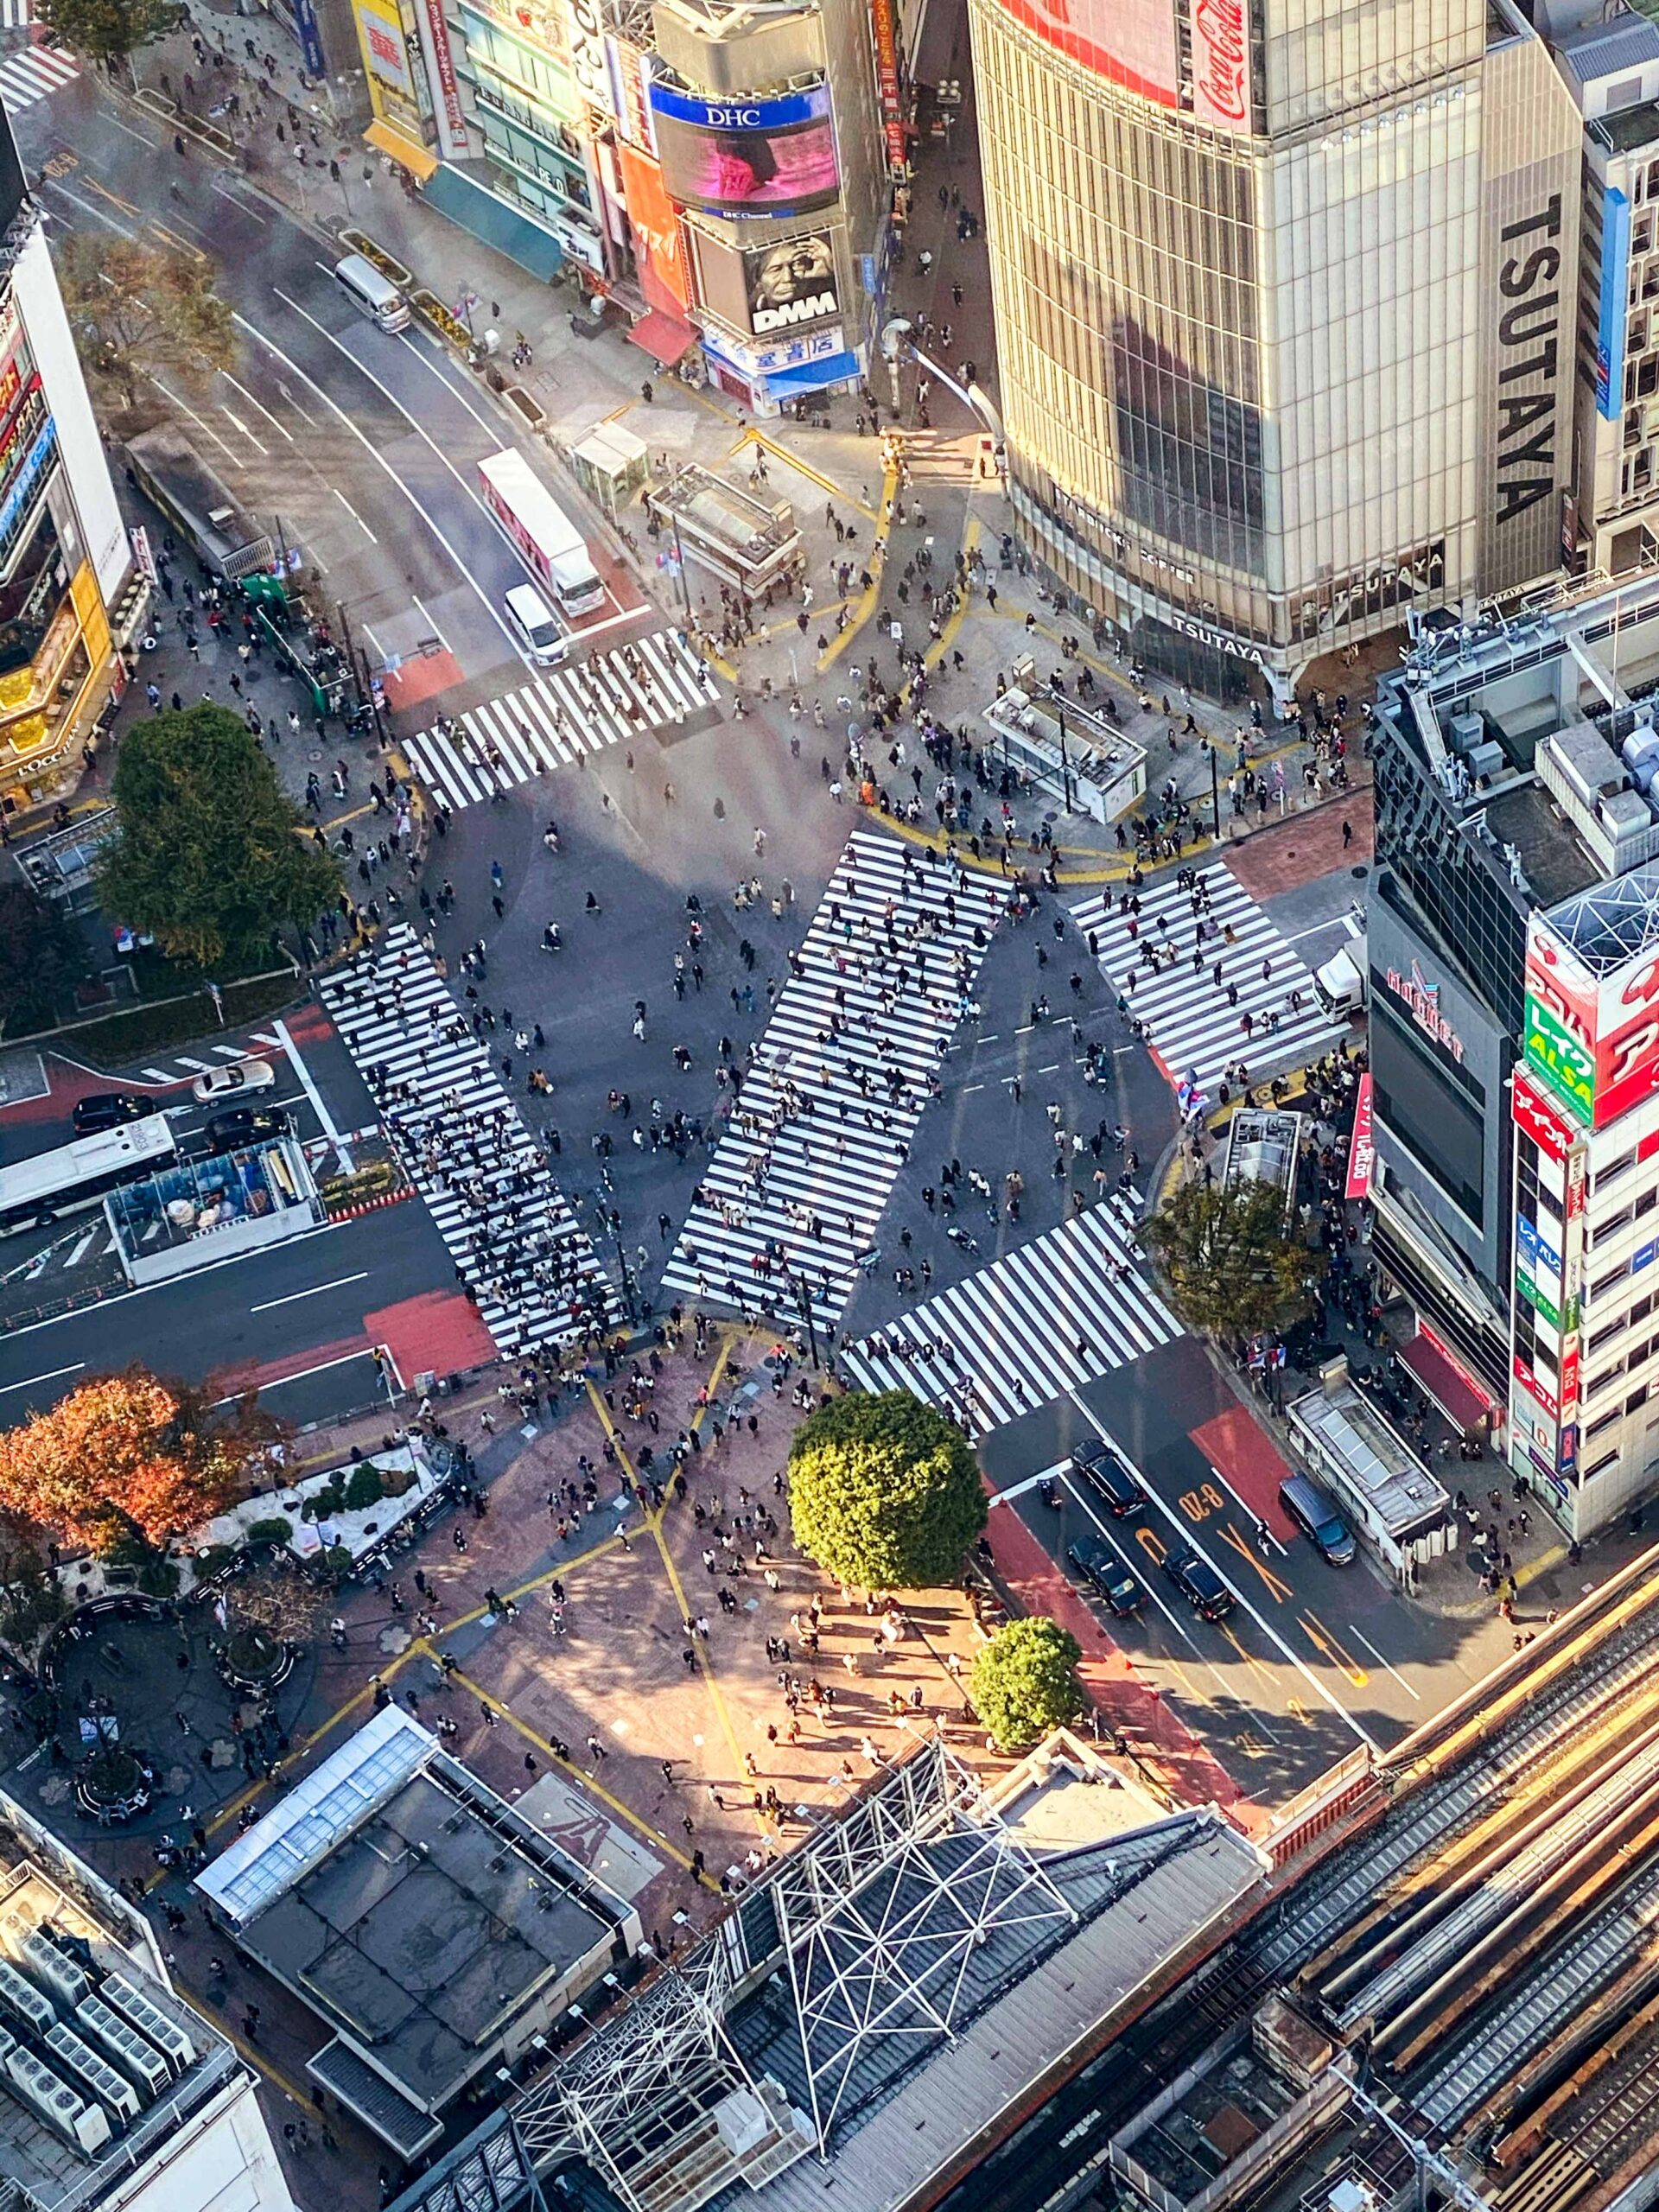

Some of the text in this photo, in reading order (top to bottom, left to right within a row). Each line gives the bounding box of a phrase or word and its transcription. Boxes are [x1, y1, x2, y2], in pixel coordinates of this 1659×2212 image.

[1197, 0, 1245, 120] Coca-Cola
[706, 107, 760, 126] DHC
[723, 211, 741, 219] DHC
[753, 291, 837, 334] DMM
[1496, 193, 1561, 526] TSUTAYA
[1335, 552, 1444, 603] TSUTAYA
[1173, 616, 1264, 664] TSUTAYA
[1530, 1003, 1592, 1077] レイク
[1529, 1033, 1592, 1109] ALSA
